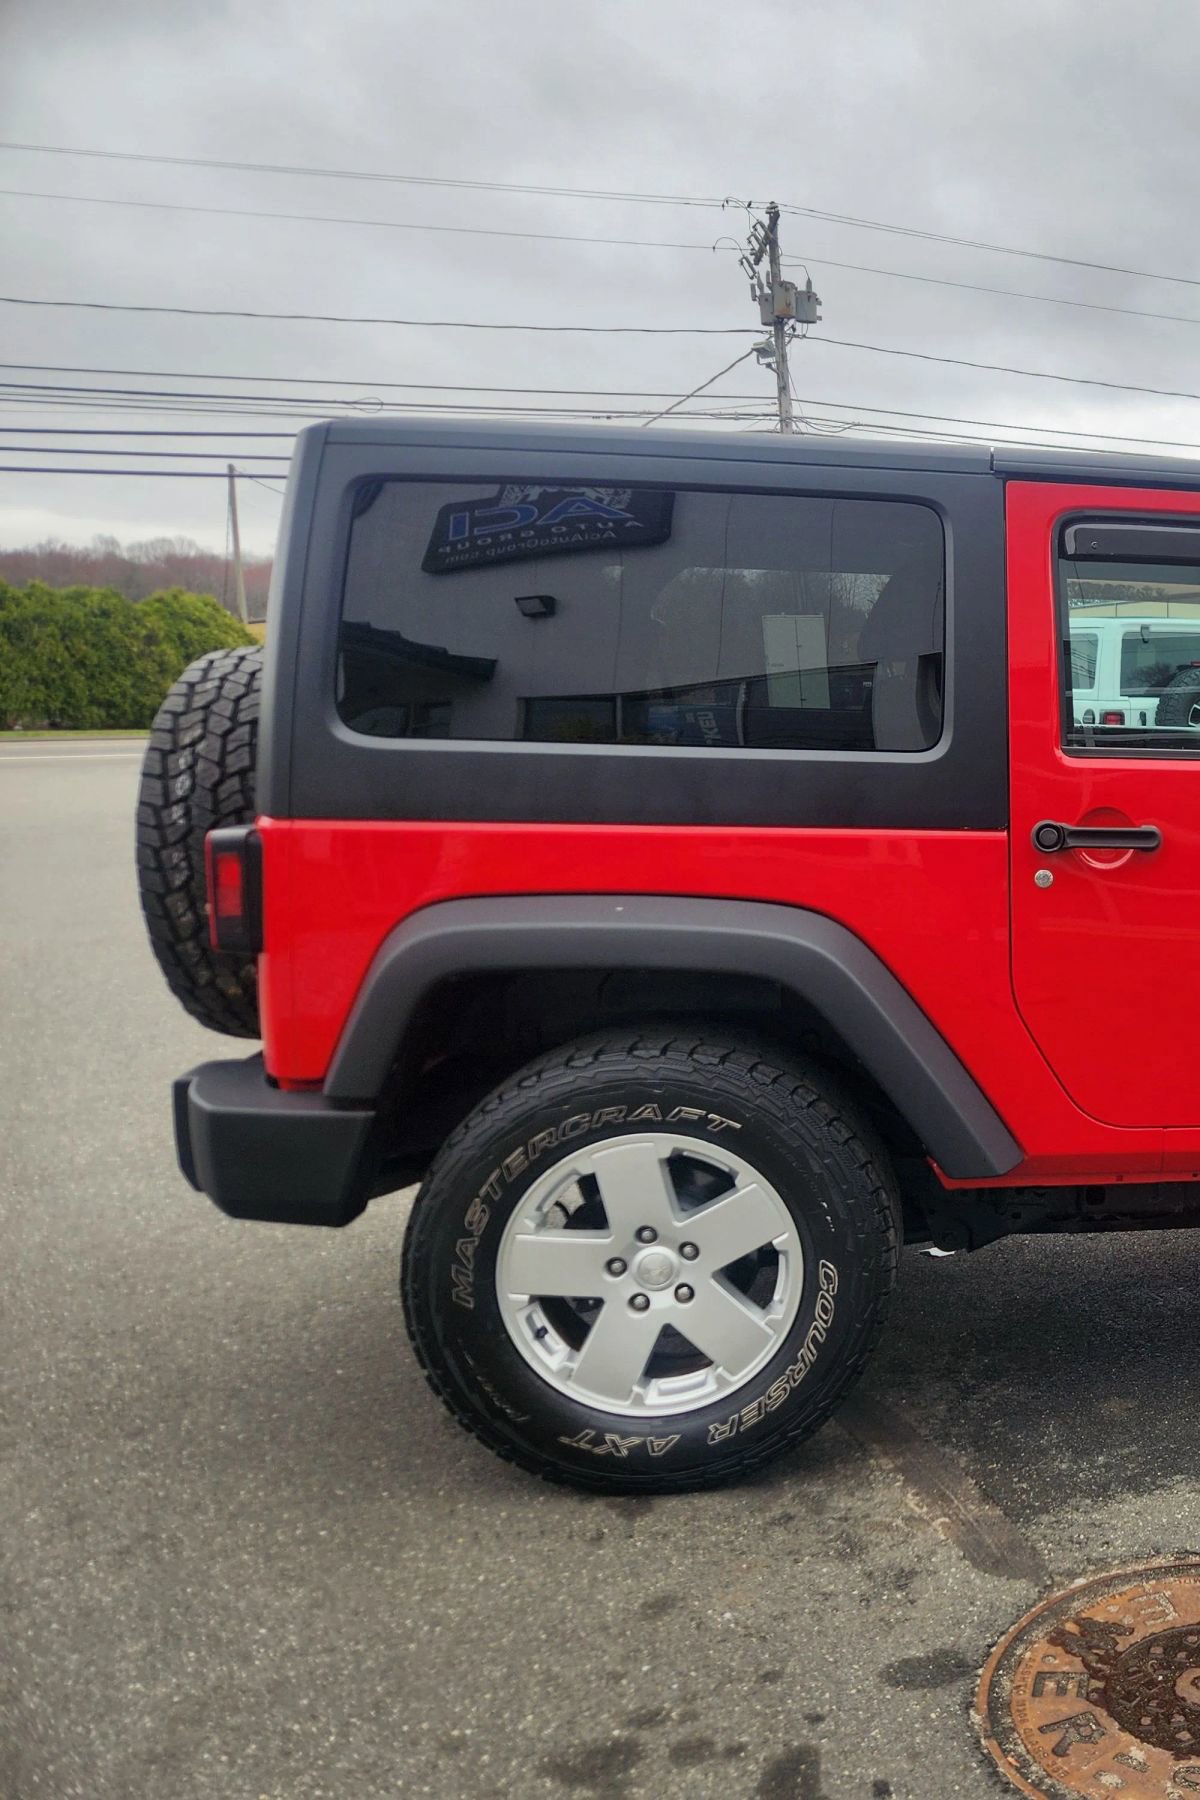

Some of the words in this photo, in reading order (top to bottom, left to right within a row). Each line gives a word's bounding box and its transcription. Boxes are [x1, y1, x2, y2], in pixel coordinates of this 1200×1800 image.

[451, 1103, 742, 1309] MASTERCRAFT
[563, 1429, 681, 1457] AXT
[707, 1259, 839, 1446] COURSER
